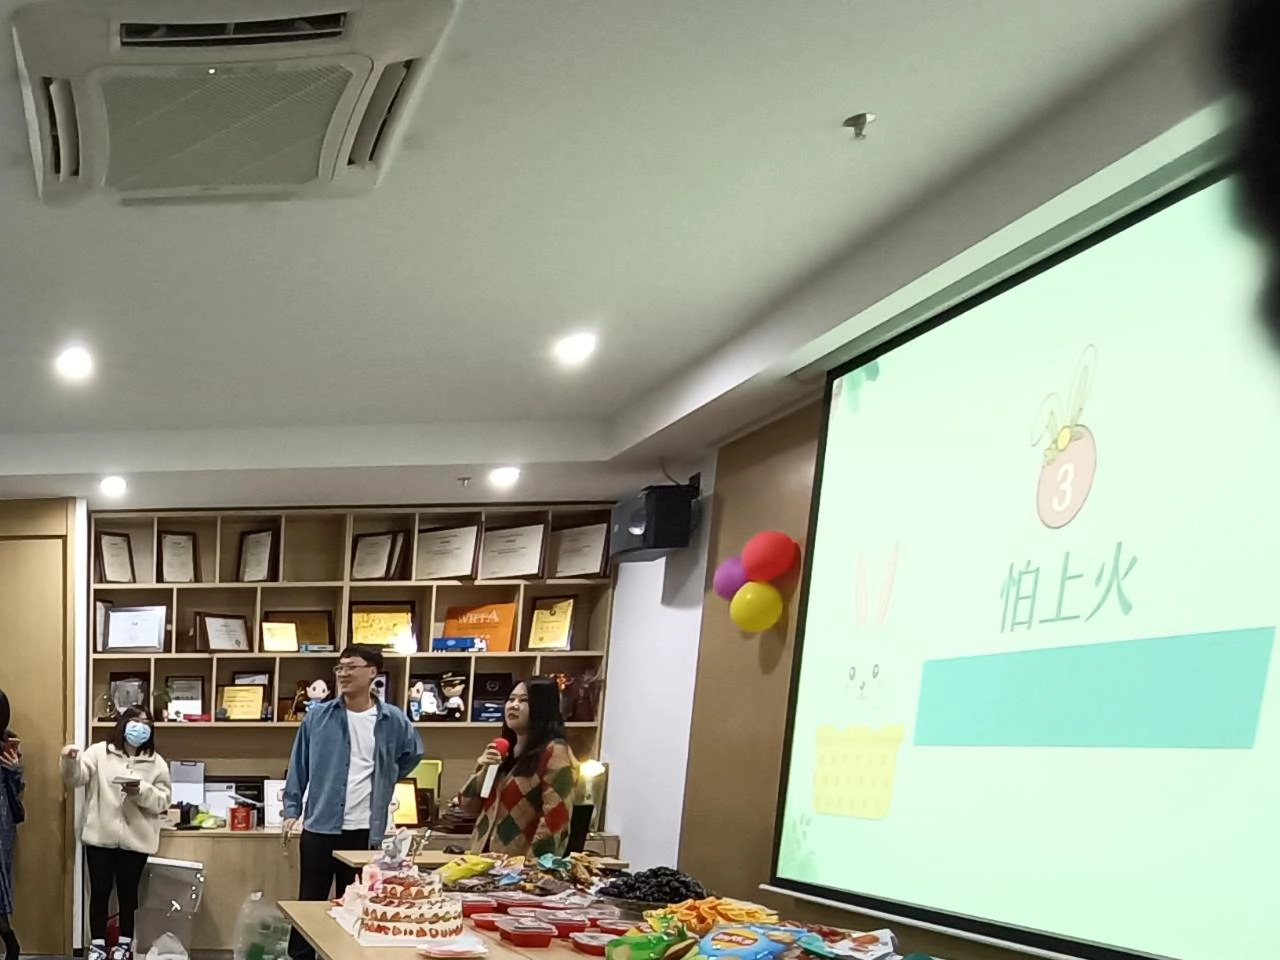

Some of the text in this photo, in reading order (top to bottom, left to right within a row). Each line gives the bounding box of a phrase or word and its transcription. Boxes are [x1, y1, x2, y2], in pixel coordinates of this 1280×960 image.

[1052, 463, 1074, 512] 3
[1000, 541, 1138, 633] 怕上火
